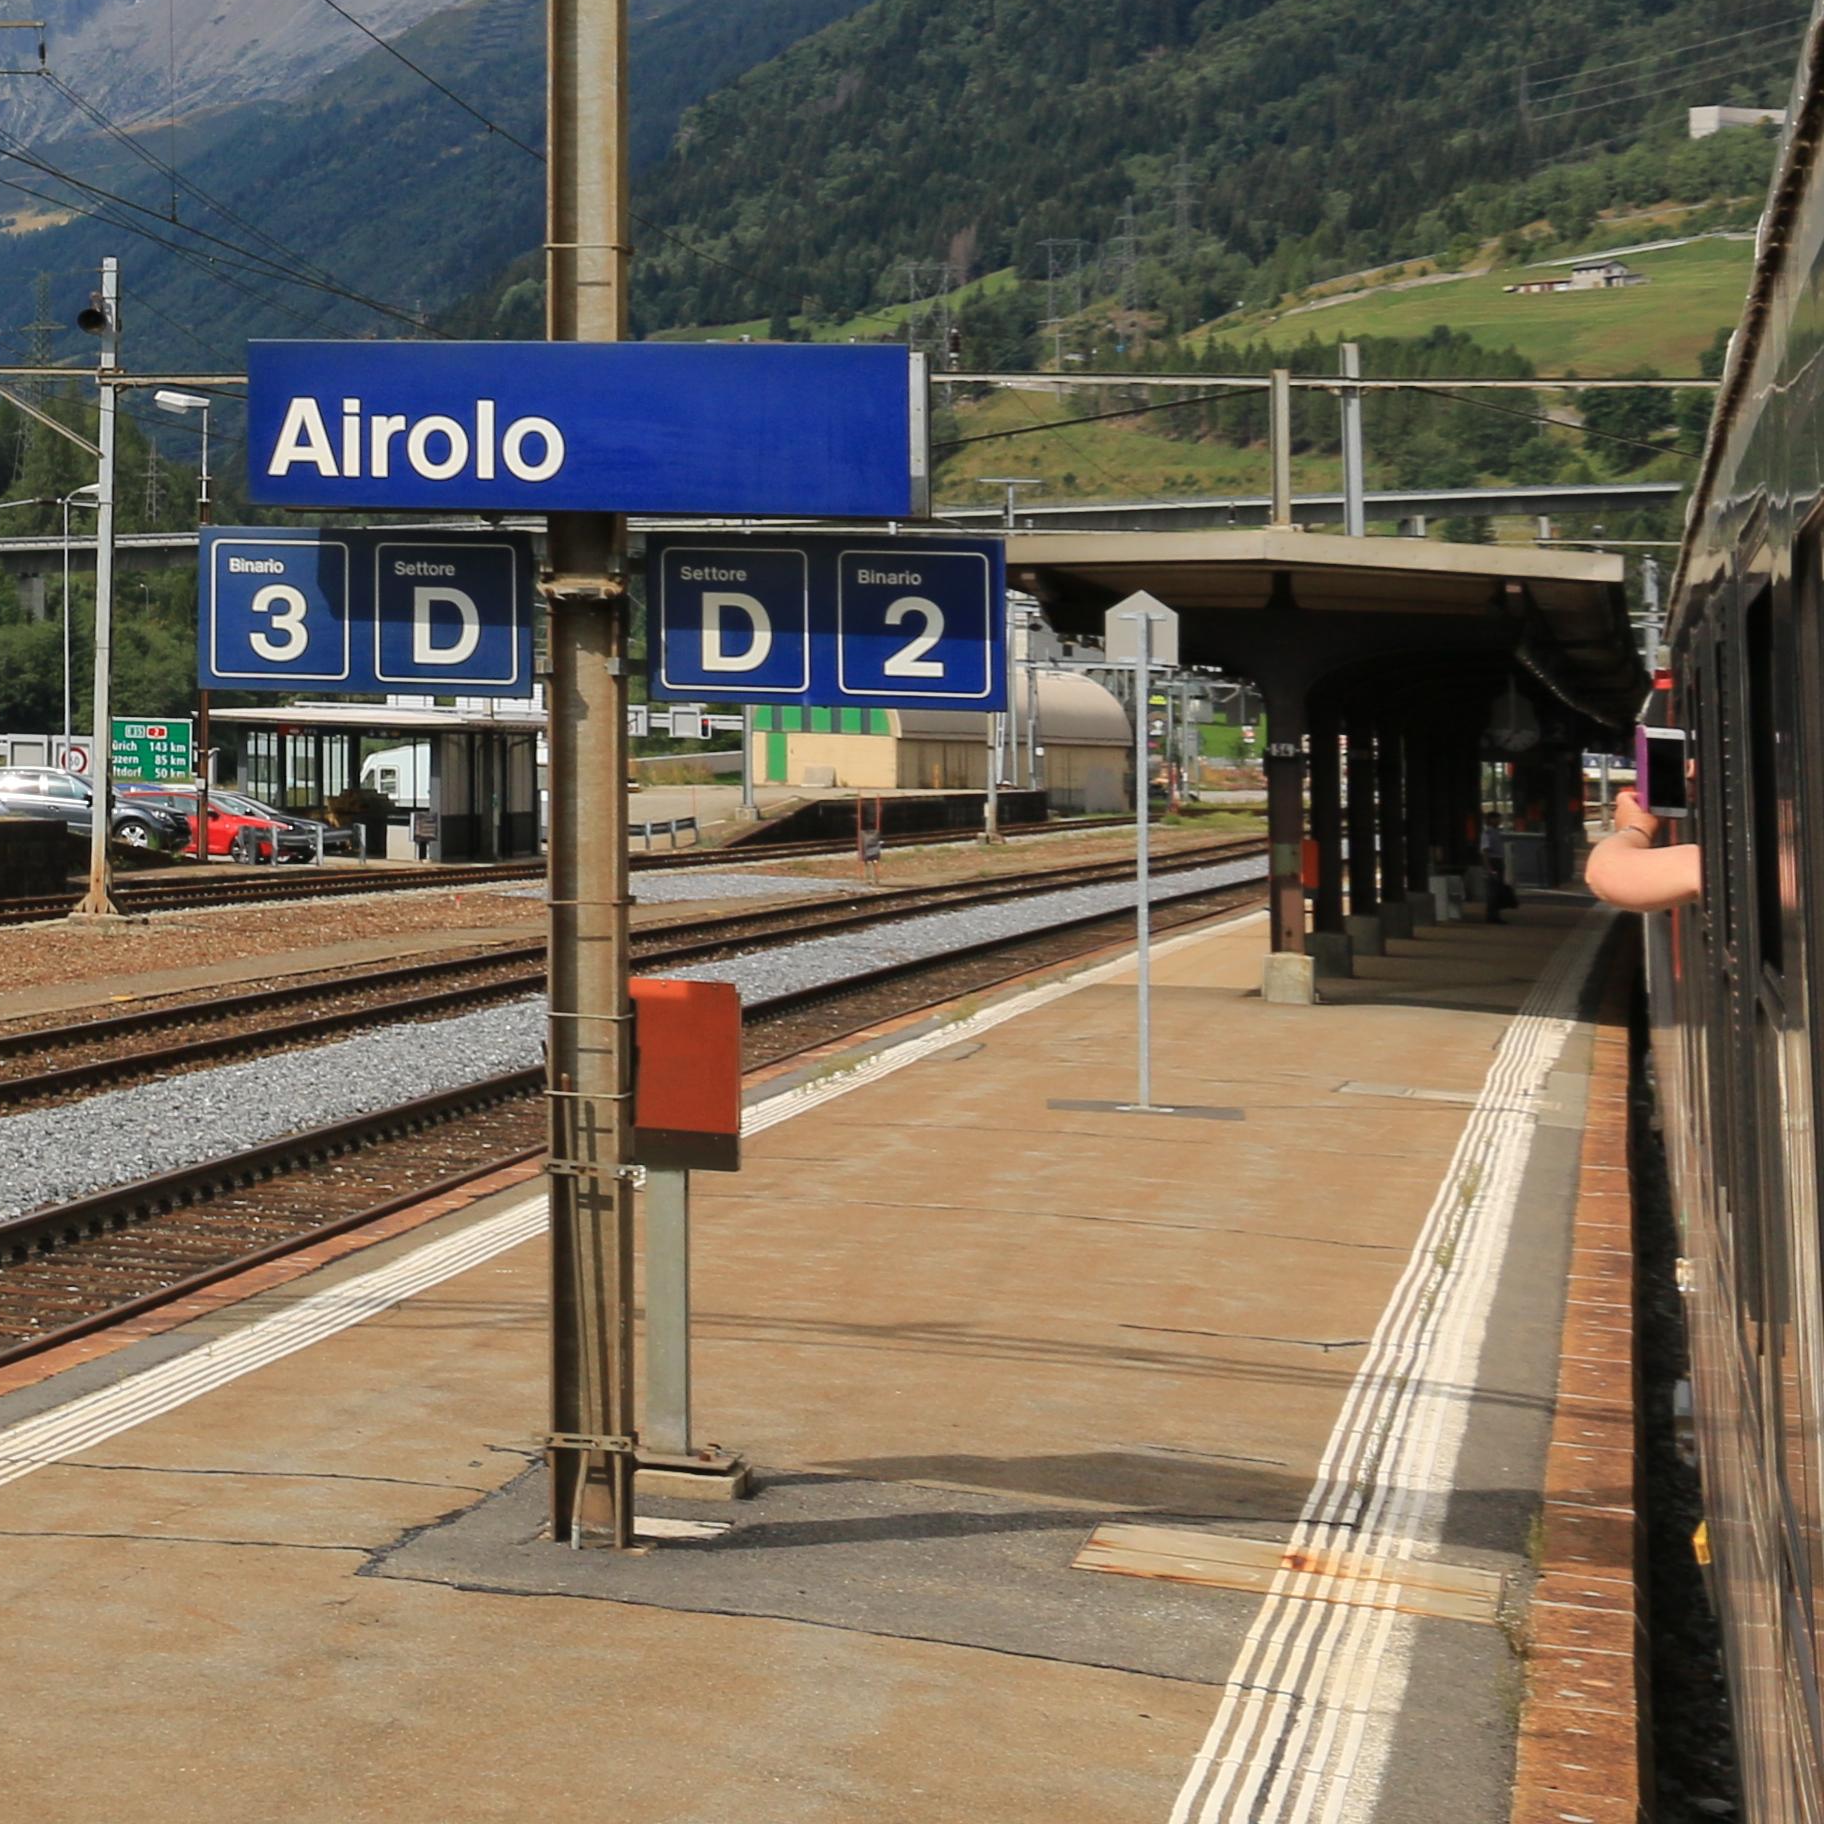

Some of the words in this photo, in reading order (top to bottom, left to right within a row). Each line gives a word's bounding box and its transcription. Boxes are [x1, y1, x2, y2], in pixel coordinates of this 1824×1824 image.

[267, 396, 566, 483] Airolo
[228, 556, 285, 575] Binario
[394, 560, 456, 577] Settore
[680, 565, 748, 582] Settore
[857, 568, 923, 586] Binario
[249, 583, 309, 662] 3
[412, 585, 481, 665] D
[701, 591, 773, 672] D
[884, 596, 945, 678] 2
[112, 740, 137, 751] ürich
[150, 742, 168, 752] 143
[170, 742, 186, 752] km
[112, 756, 139, 764] uzern
[155, 755, 168, 765] 85
[170, 755, 186, 765] km
[113, 766, 142, 776] ltdorf
[155, 768, 168, 778] 50
[170, 768, 186, 778] km
